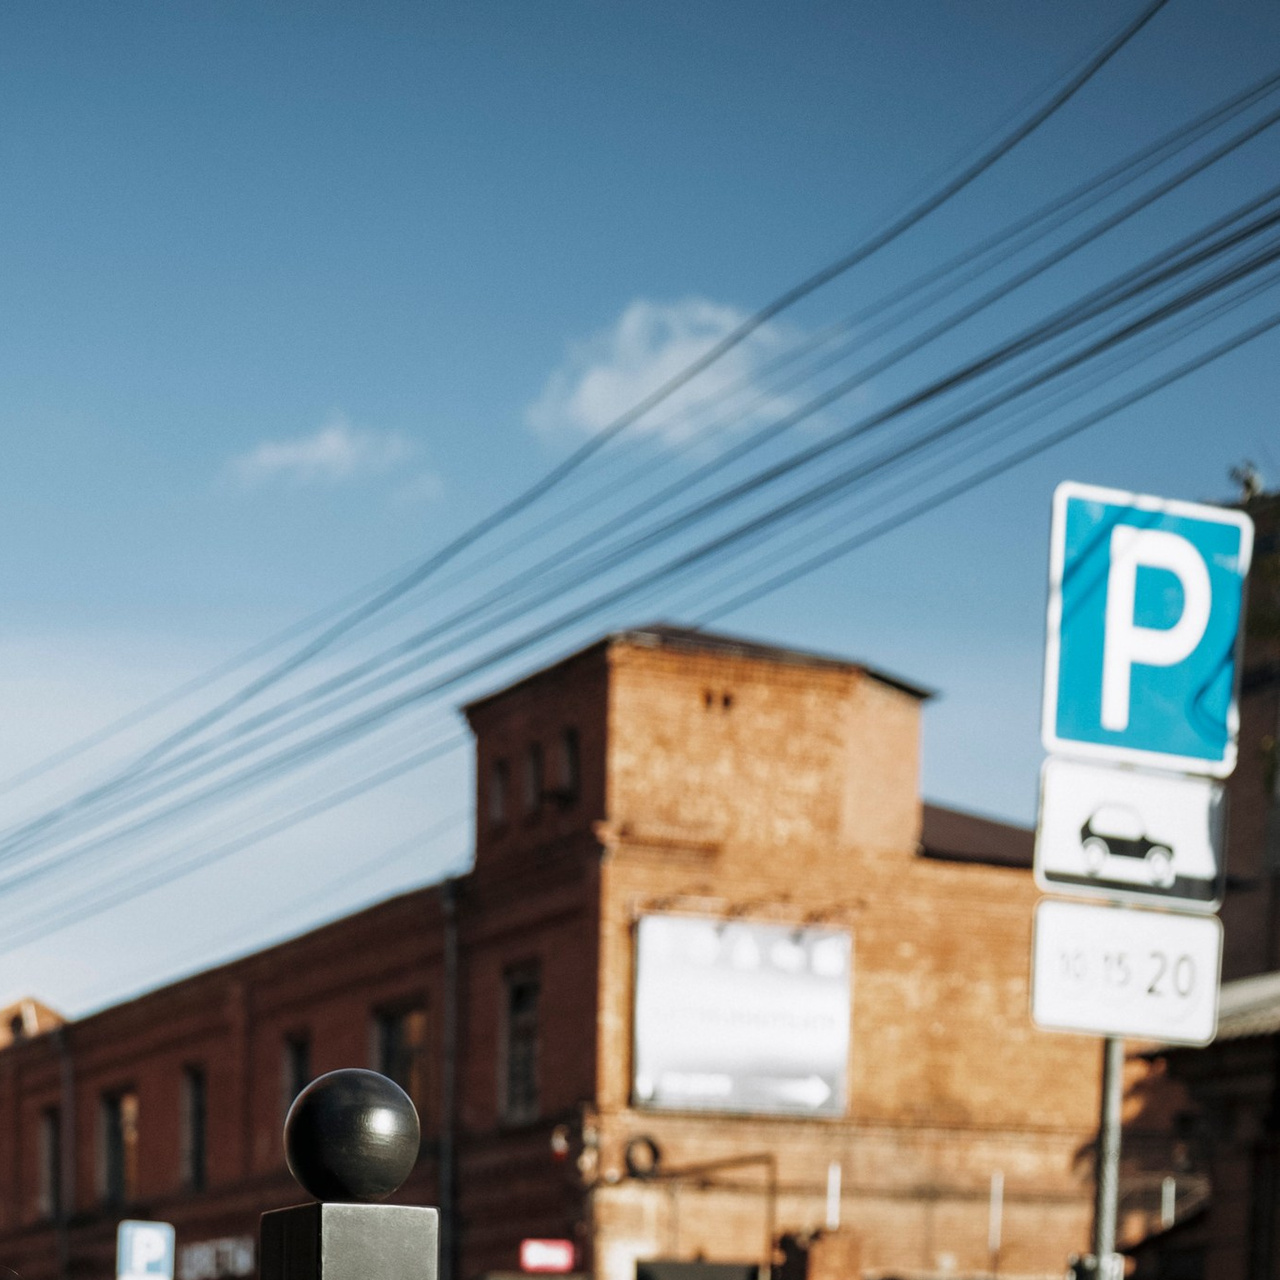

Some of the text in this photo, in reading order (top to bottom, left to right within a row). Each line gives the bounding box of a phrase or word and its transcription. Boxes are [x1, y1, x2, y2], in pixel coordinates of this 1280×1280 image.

[1100, 524, 1212, 731] P
[1146, 949, 1197, 1000] 20
[132, 1228, 166, 1275] P
